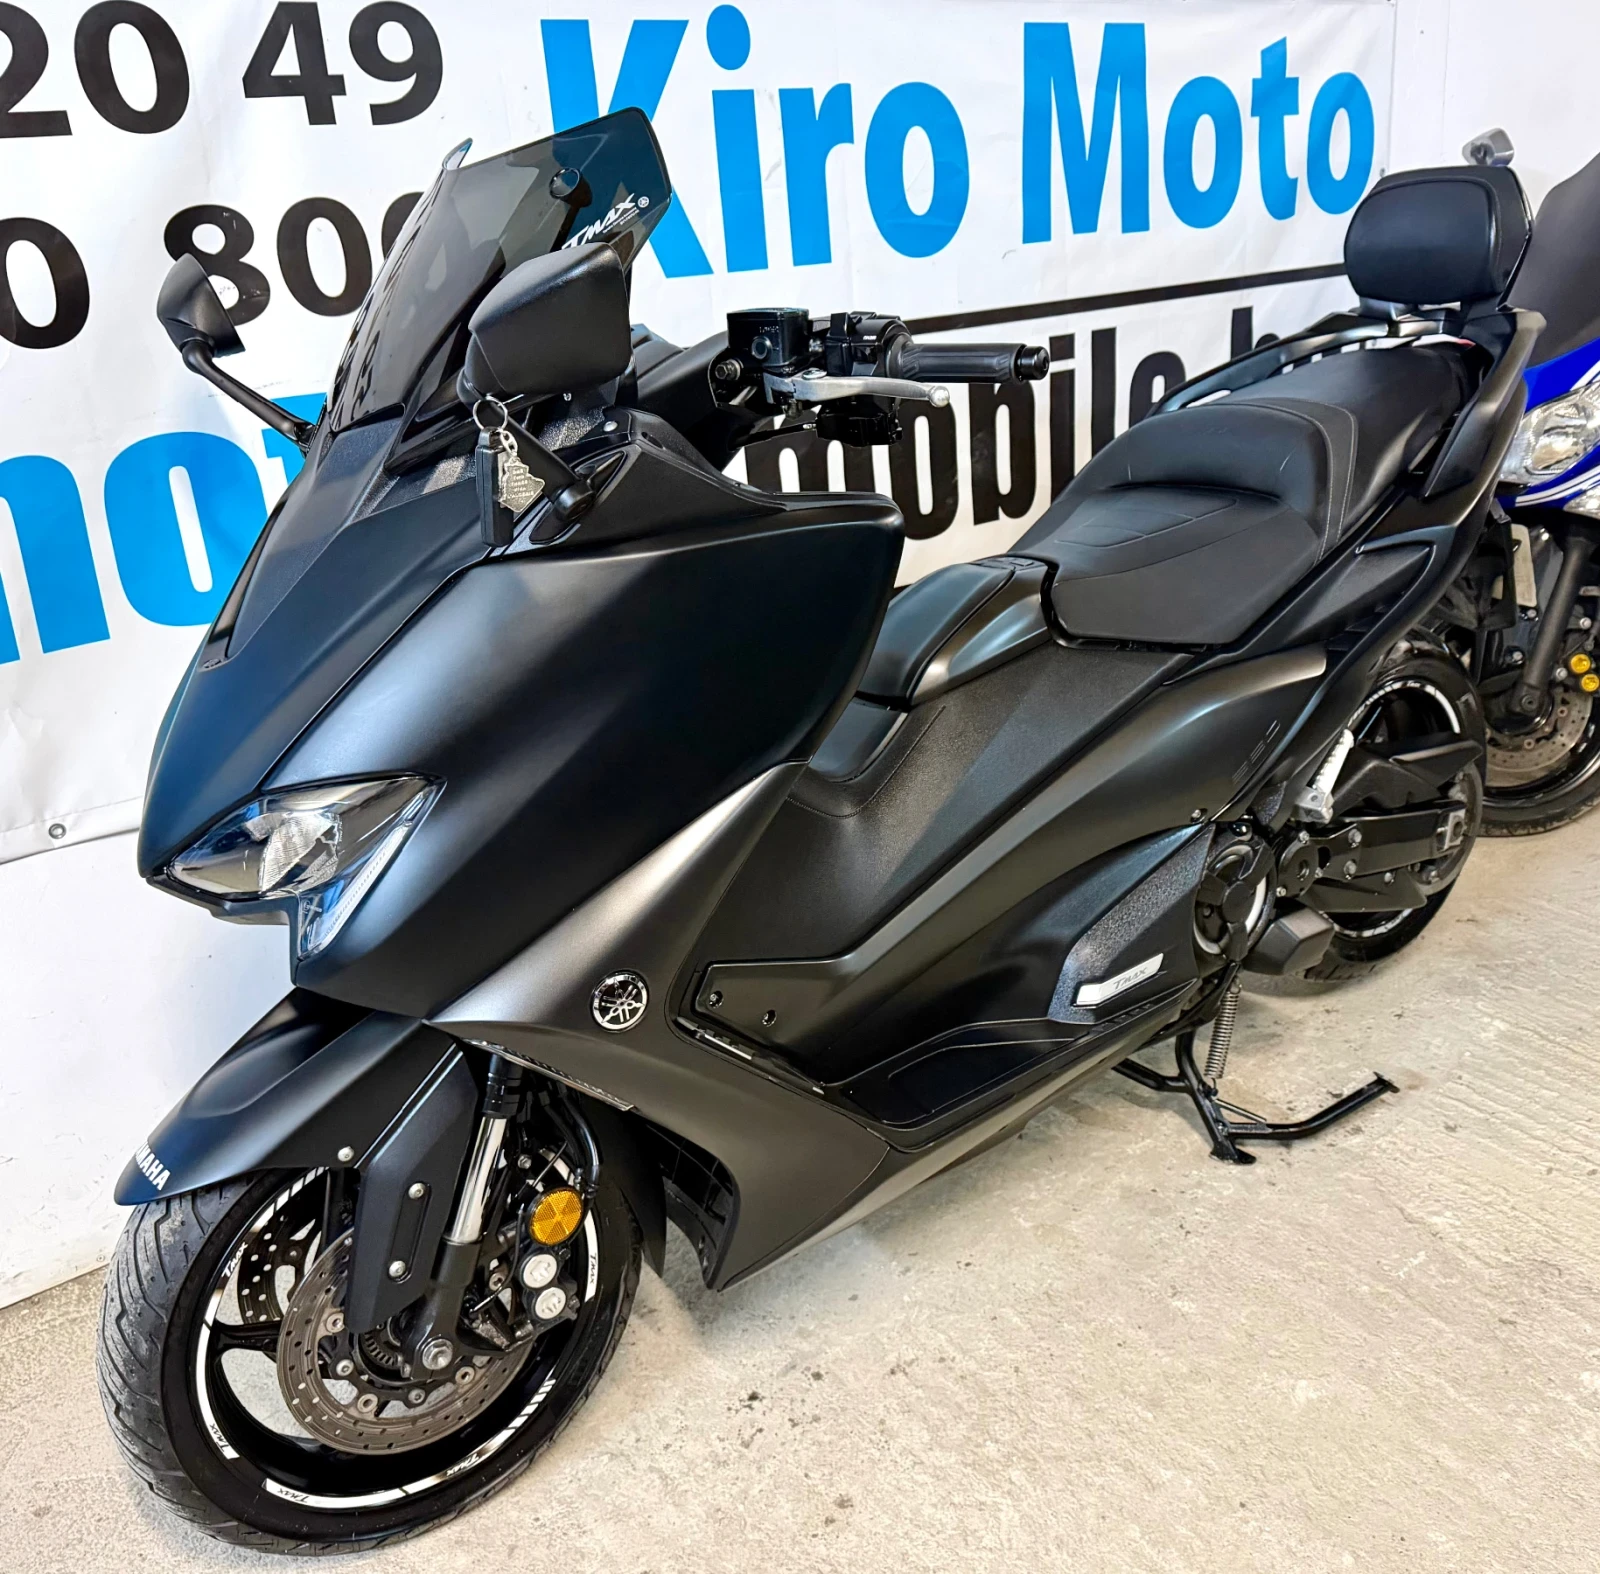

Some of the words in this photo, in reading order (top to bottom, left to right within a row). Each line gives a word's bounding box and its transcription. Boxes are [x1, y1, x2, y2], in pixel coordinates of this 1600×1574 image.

[0, 0, 190, 137] 20
[243, 1, 443, 126] 49
[540, 4, 970, 278] Kiro
[1022, 22, 1375, 244] Moto
[561, 193, 636, 249] TMAX
[164, 192, 422, 327] 80
[1112, 966, 1148, 990] TMAX
[221, 1241, 249, 1278] TMAX
[277, 1487, 310, 1503] TMAX
